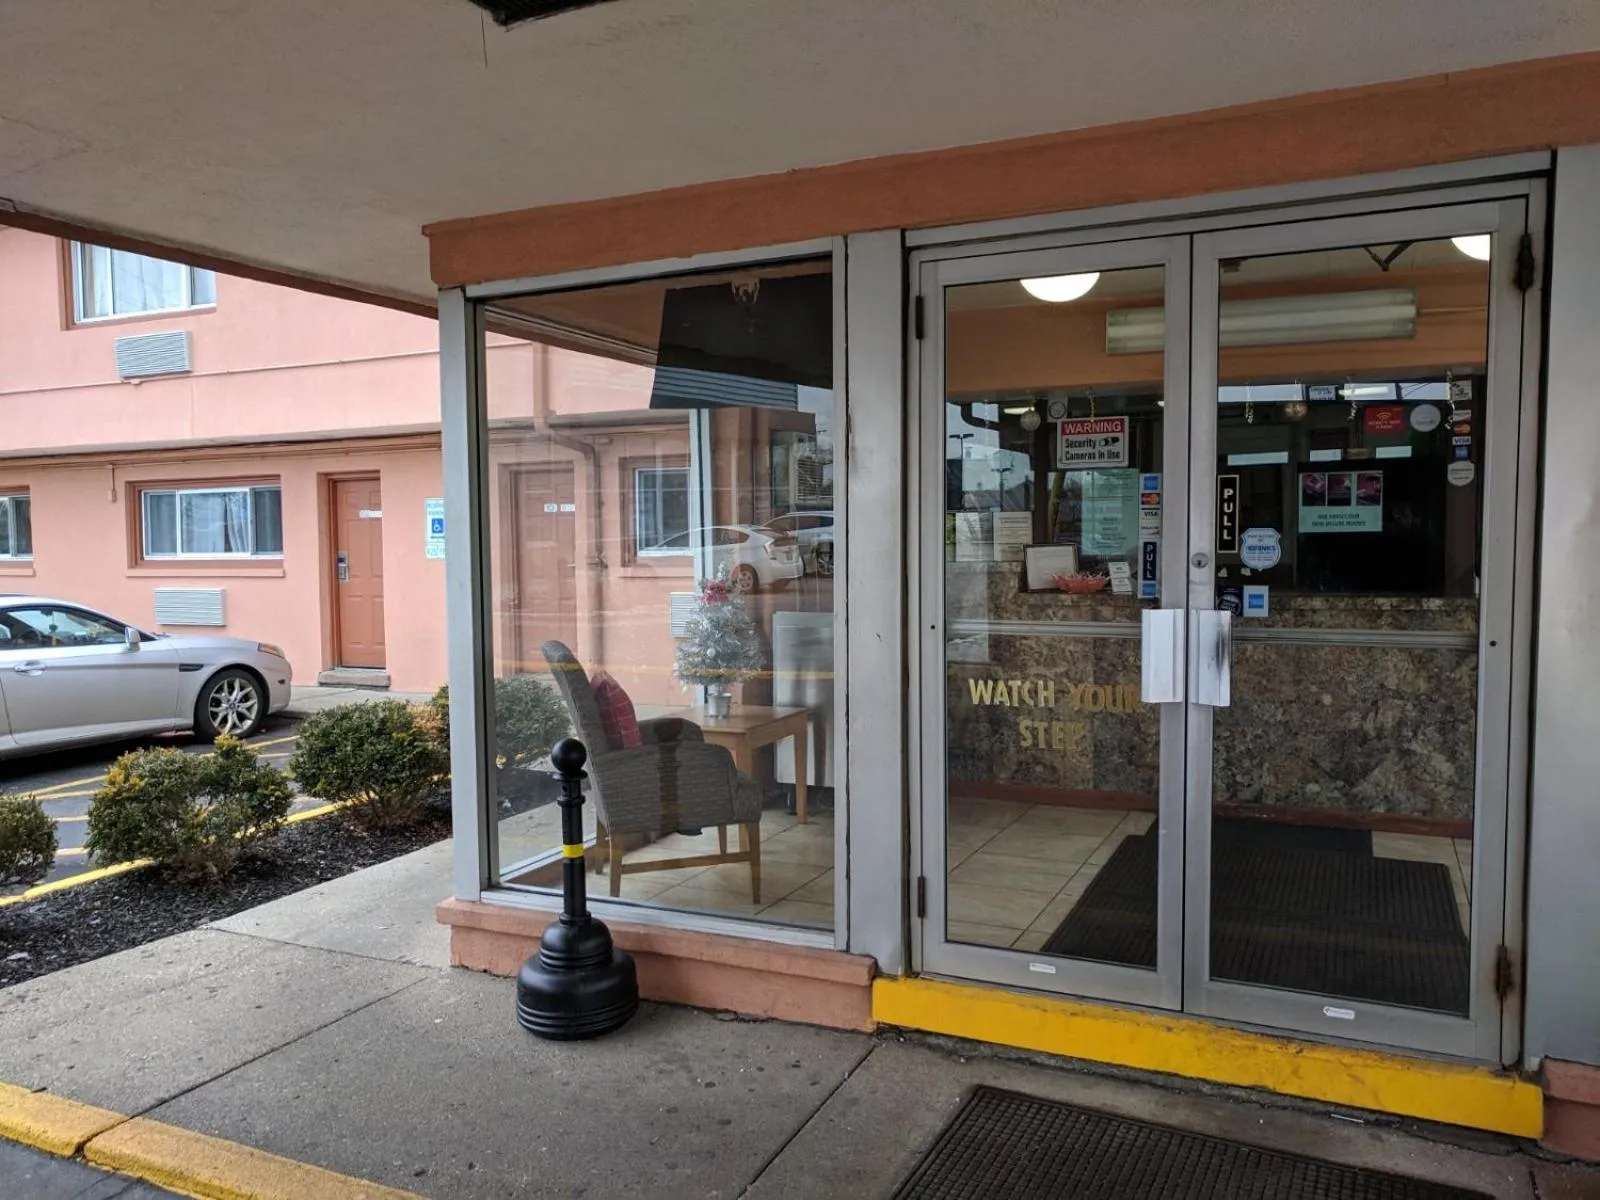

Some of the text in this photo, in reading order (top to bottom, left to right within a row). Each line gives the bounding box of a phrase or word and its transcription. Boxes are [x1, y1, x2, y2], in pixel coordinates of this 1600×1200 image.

[1064, 421, 1122, 434] WARNING
[1065, 437, 1096, 449] Security
[1065, 450, 1096, 461] Cameras
[1107, 448, 1121, 460] Use
[1223, 488, 1234, 540] PULL
[1146, 544, 1154, 579] PULL
[968, 678, 1145, 713] WATCH YOUR
[1019, 719, 1085, 750] STEP
